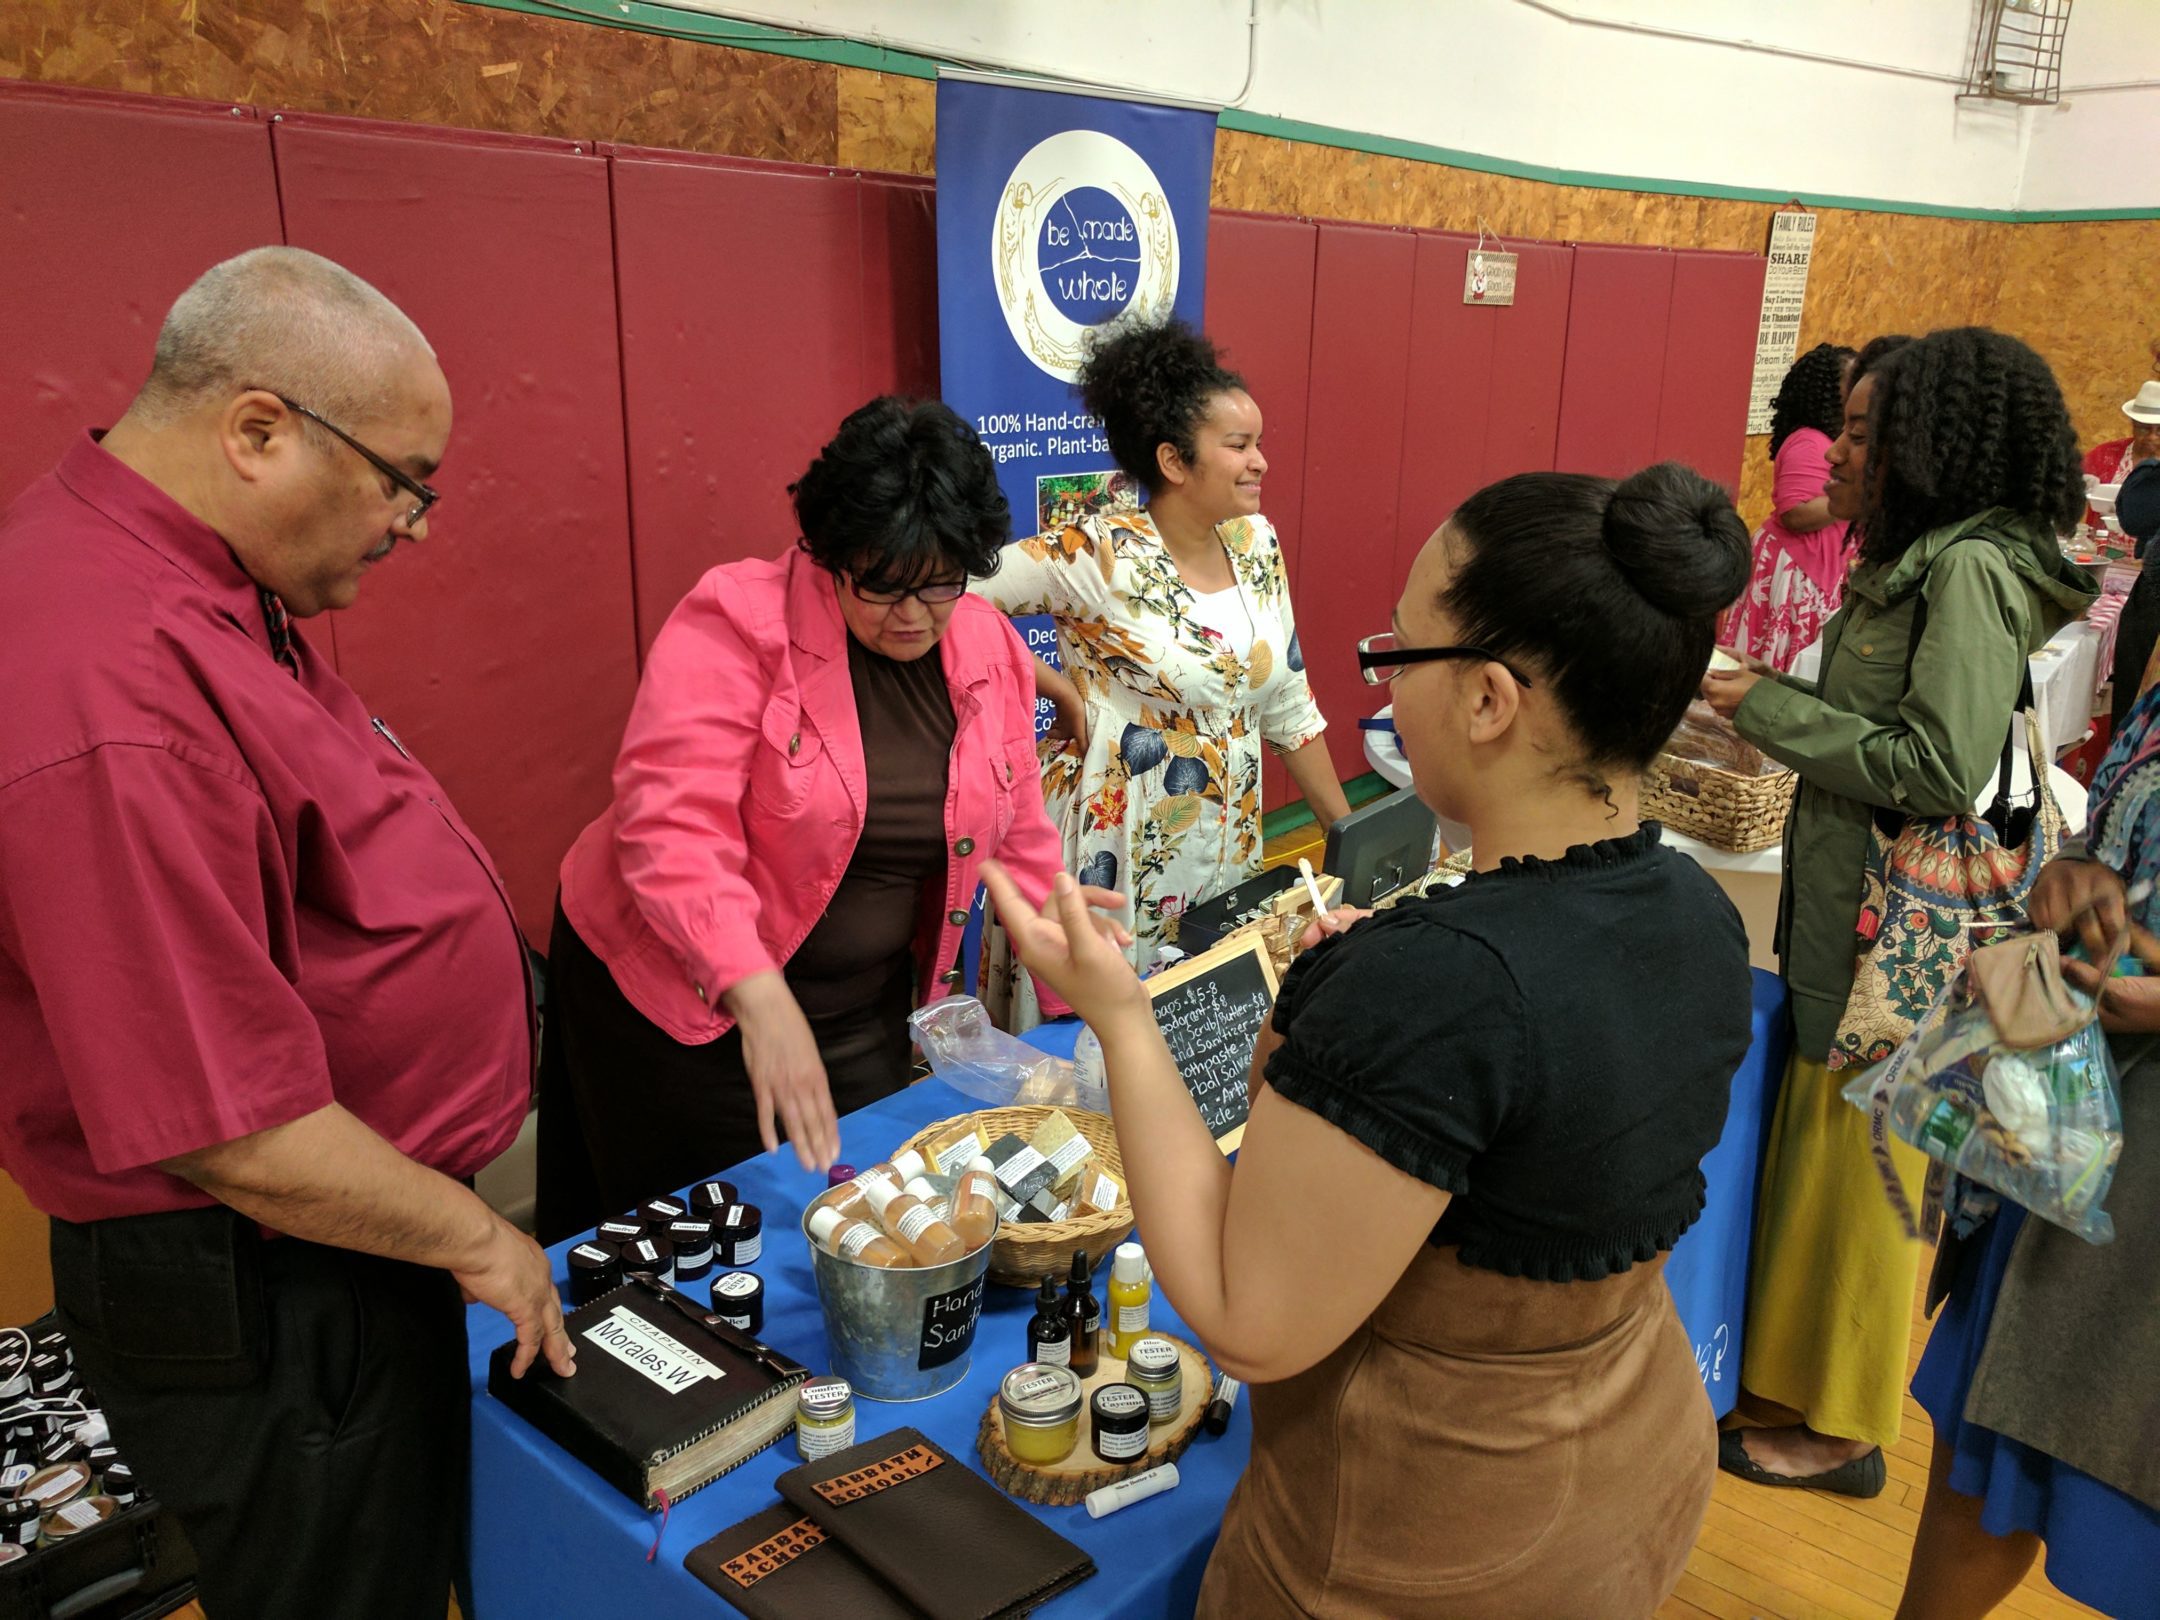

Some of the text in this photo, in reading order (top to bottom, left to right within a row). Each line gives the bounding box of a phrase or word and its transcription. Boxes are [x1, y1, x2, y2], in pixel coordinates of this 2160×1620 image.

[1047, 217, 1134, 246] be made
[1775, 215, 1815, 232] FAMILY RULES
[1770, 253, 1808, 265] SHARE
[1059, 270, 1127, 301] whole
[1764, 295, 1775, 304] Say
[1780, 296, 1791, 304] love
[1791, 297, 1802, 305] you
[1761, 313, 1800, 322] Be Thankful
[1759, 331, 1797, 345] BE HAPPY
[1756, 353, 1780, 365] Dream
[977, 411, 1106, 435] 100% Hand-cra
[1048, 434, 1110, 455] Plant-ba
[1885, 1048, 1910, 1083] ORMC
[1189, 1069, 1220, 1097] rbal
[1206, 1106, 1235, 1130] scle
[723, 1276, 749, 1292] TESTER
[932, 1273, 984, 1318] Hand
[629, 1316, 706, 1366] CHAPLAIN
[594, 1321, 698, 1386] Morales, W
[1138, 1346, 1173, 1354] TESTER
[804, 1384, 846, 1394] Comfrey
[1020, 1376, 1055, 1391] TESTER
[808, 1390, 844, 1400] TESTER
[1101, 1394, 1136, 1402] TESTER
[1102, 1400, 1144, 1408] Cayenne
[818, 1448, 923, 1494] SABBATH
[829, 1466, 921, 1504] SCHOOL
